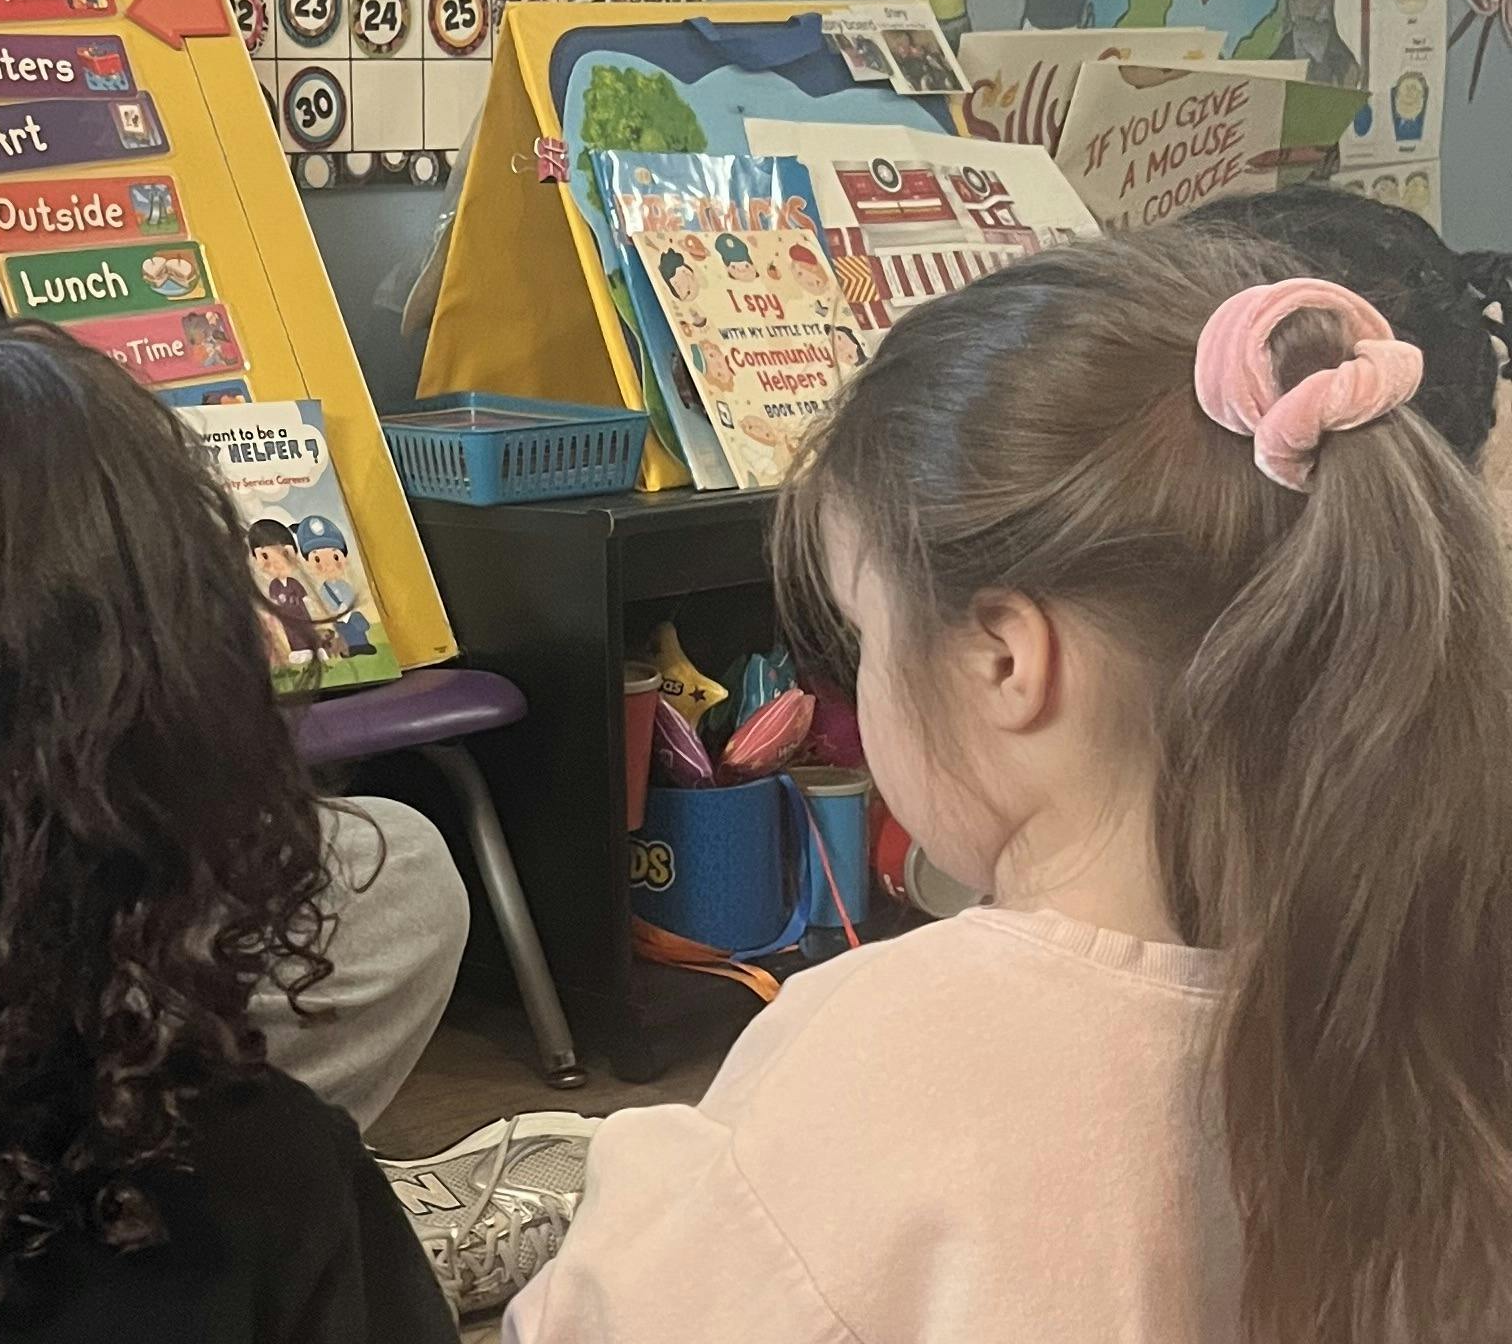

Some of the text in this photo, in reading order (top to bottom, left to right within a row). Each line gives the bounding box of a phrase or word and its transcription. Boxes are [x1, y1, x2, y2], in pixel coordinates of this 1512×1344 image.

[365, 0, 397, 32] 24
[295, 87, 334, 129] 30
[1084, 80, 1250, 177] IF YOU GIVE
[1120, 118, 1245, 199] A MOUSE
[1143, 152, 1245, 227] COOKIE
[20, 261, 129, 307] Lunch
[727, 289, 785, 320] I spy
[718, 327, 746, 340] WITH
[747, 327, 764, 338] MY
[766, 324, 801, 337] LITTLE
[126, 337, 185, 365] Time
[731, 343, 835, 369] Community
[757, 370, 827, 395] Helpers
[764, 402, 795, 418] BOOK
[239, 427, 254, 441] to
[256, 425, 275, 440] be
[278, 428, 287, 438] a
[243, 476, 274, 488] Service
